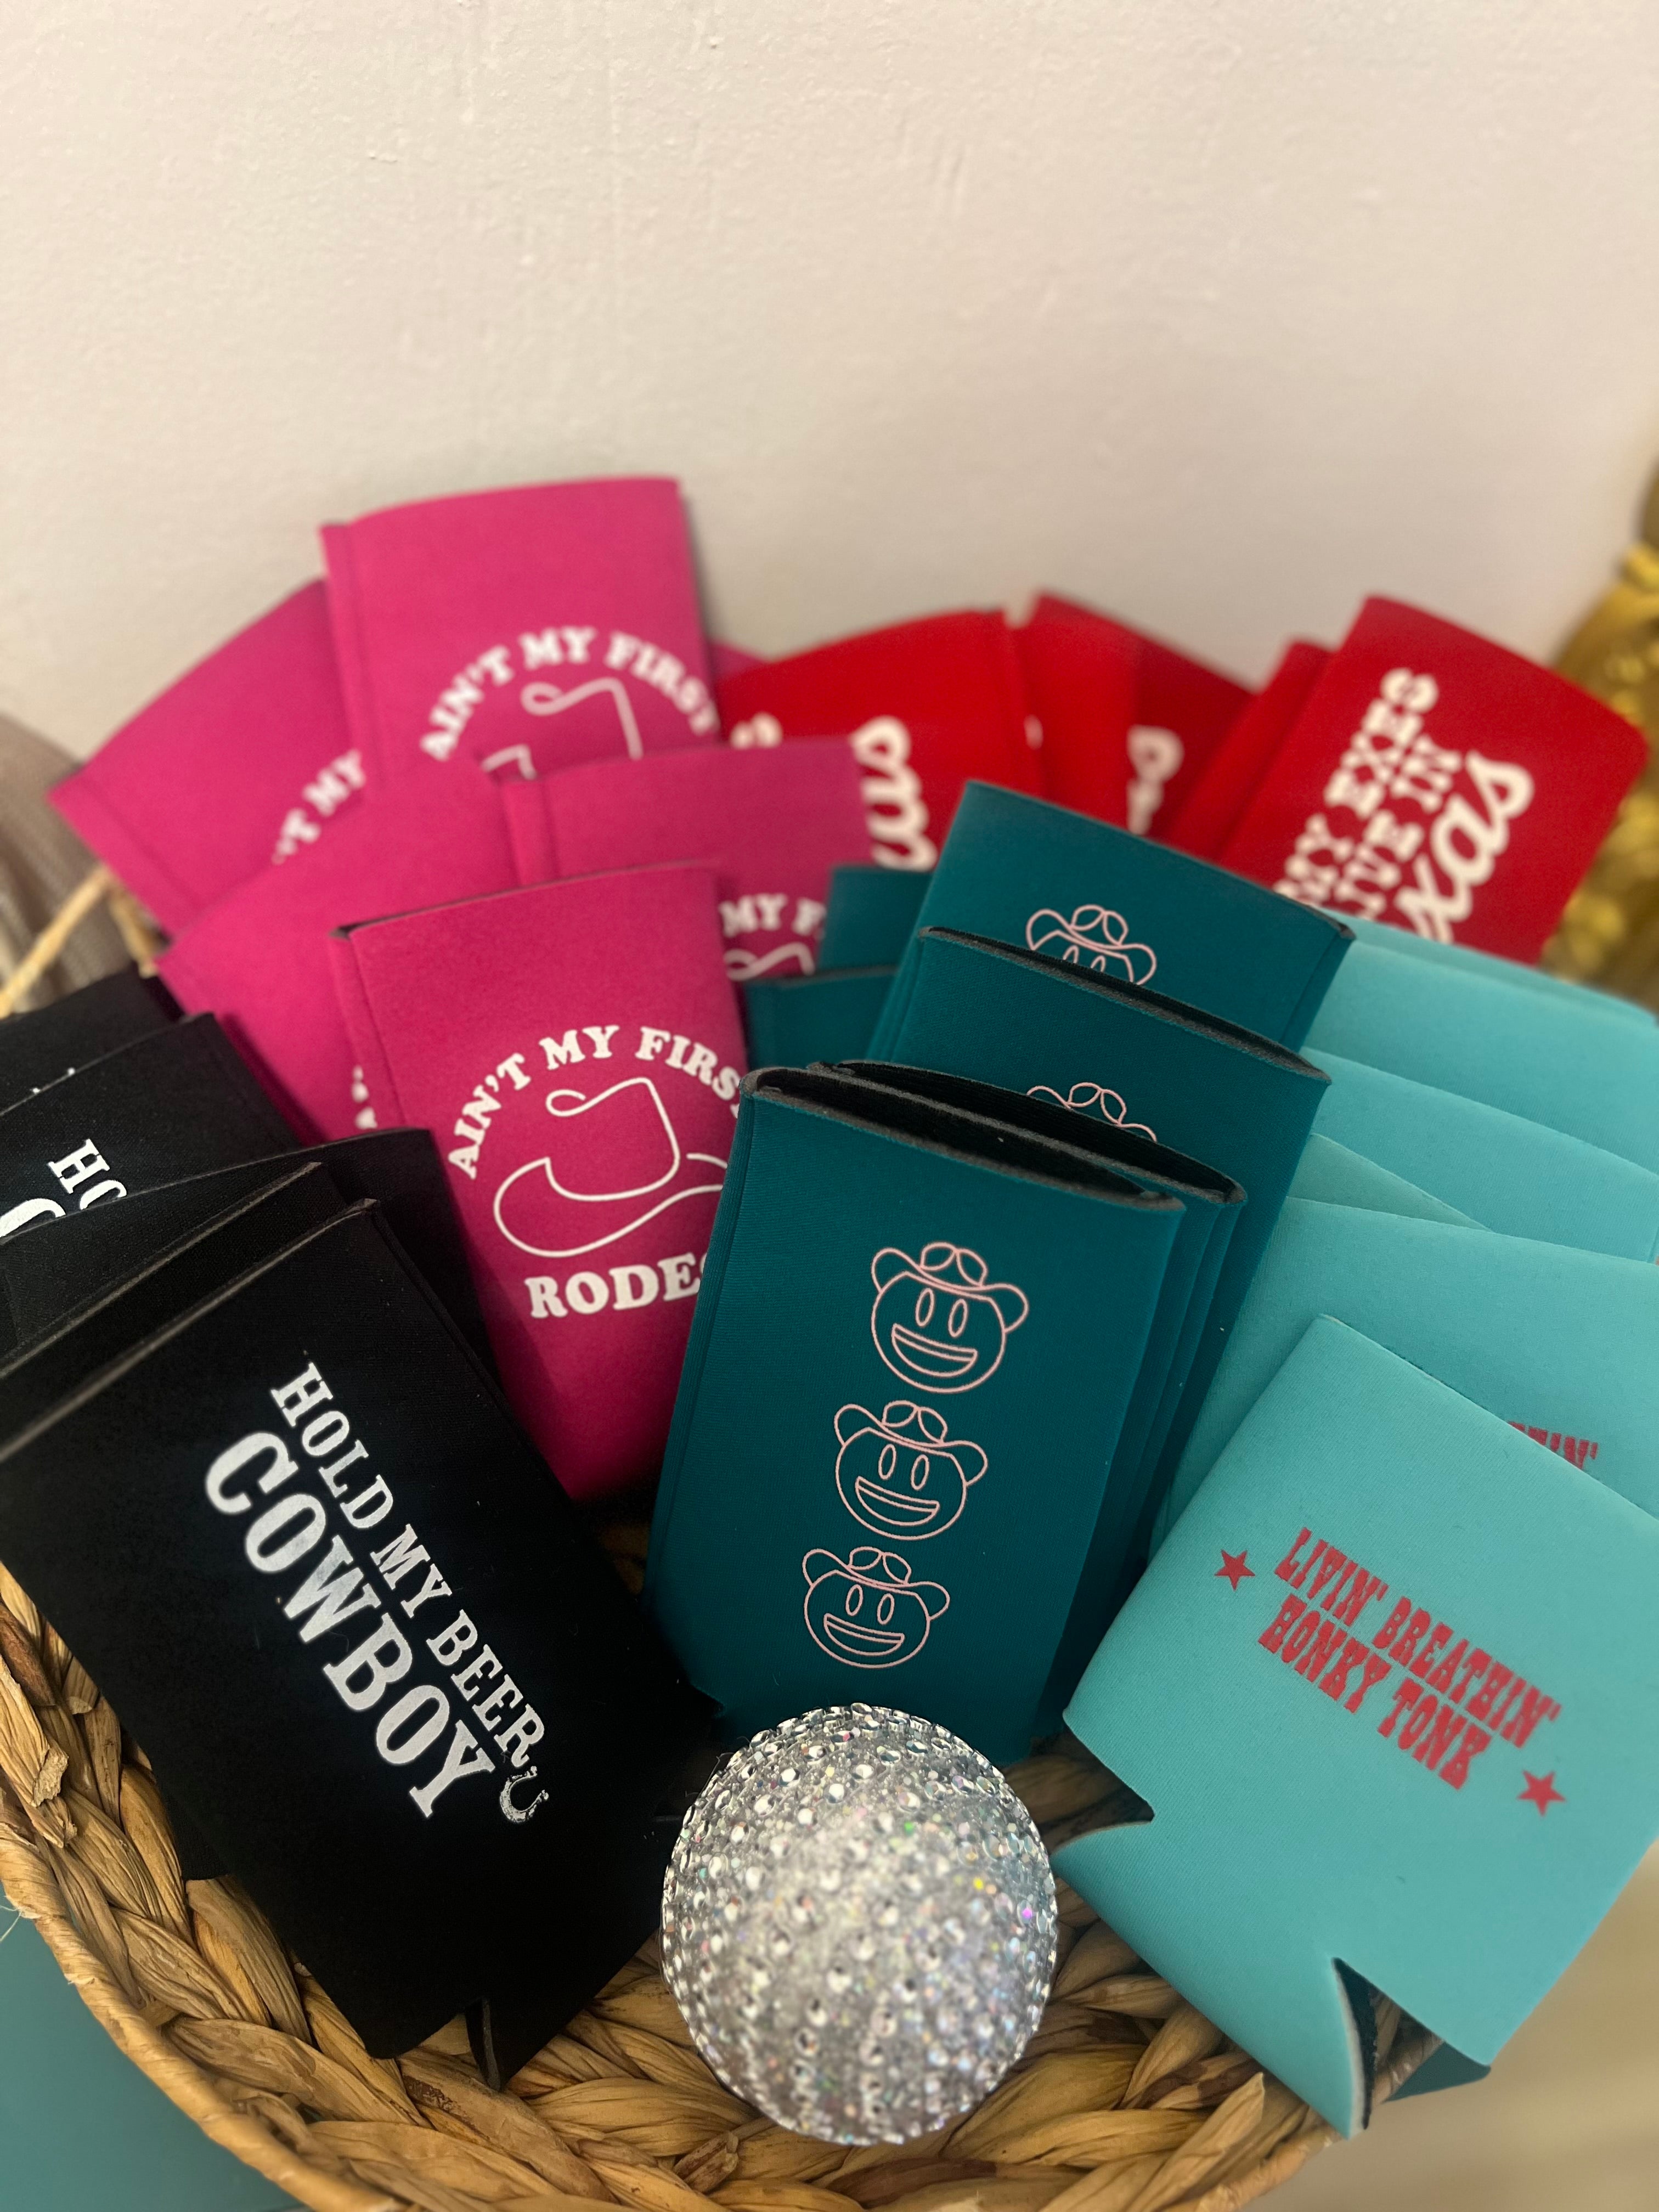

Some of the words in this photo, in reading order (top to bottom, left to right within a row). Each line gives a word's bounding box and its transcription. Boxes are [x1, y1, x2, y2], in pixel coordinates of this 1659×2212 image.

[303, 749, 365, 816] MY
[420, 644, 515, 761] AIN'T
[519, 627, 597, 670] MY
[1273, 814, 1354, 905] MY
[1323, 667, 1439, 820] EXES
[719, 893, 789, 938] MY
[1331, 810, 1425, 921] IVE
[1390, 735, 1462, 813] IN
[1396, 751, 1535, 945] xas
[449, 1054, 531, 1180] AIN'T
[539, 1025, 619, 1070] MY
[634, 1026, 740, 1119] FIRS
[524, 1252, 708, 1318] RODE
[206, 1432, 496, 1818] COWBOY
[270, 1363, 393, 1529] HOLD
[370, 1524, 453, 1618] MY
[426, 1610, 545, 1769] BEER
[1274, 1527, 1389, 1627] LIVIN'
[1372, 1595, 1562, 1748] BREATHIN'
[1257, 1593, 1391, 1714] HONKY
[1377, 1678, 1492, 1790] TONK
